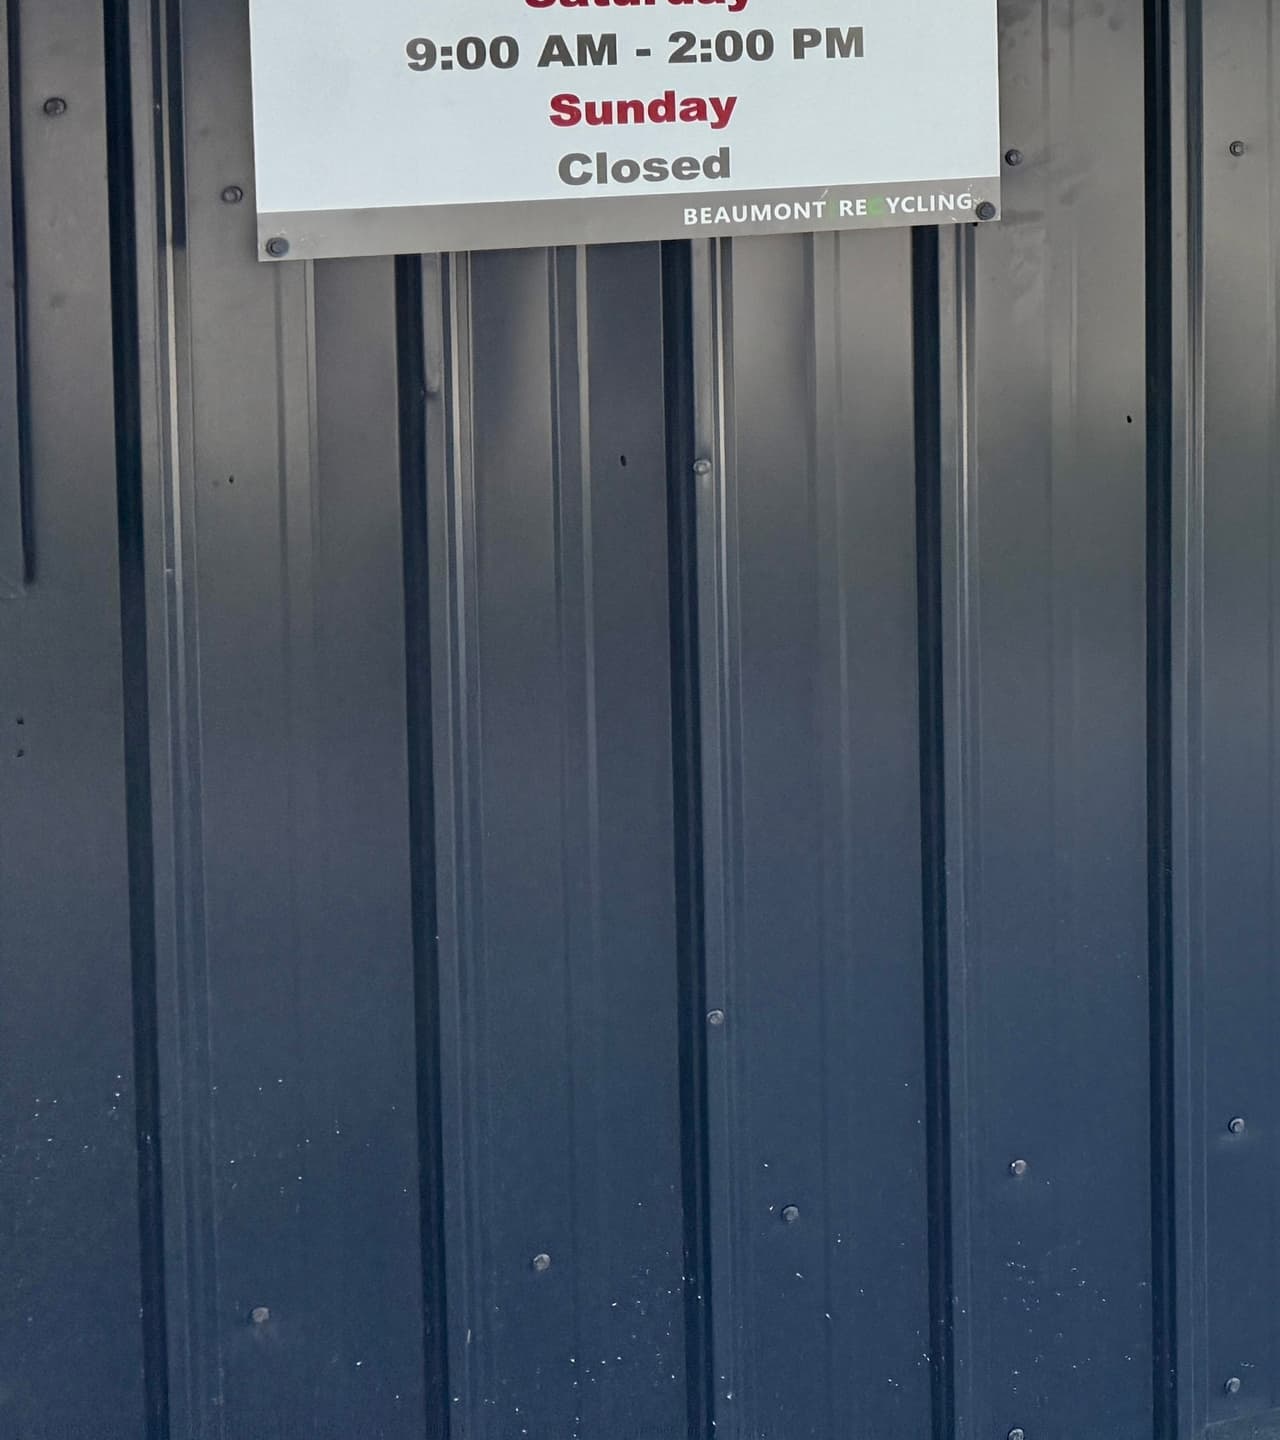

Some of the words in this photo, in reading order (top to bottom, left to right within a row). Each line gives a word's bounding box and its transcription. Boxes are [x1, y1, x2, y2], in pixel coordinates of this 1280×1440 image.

[406, 35, 520, 72] 9:00
[537, 33, 617, 68] AM
[668, 29, 774, 64] 2:00
[793, 26, 864, 60] PM
[549, 90, 738, 130] Sunday
[558, 146, 731, 186] Closed
[684, 201, 827, 225] BEAUMONT
